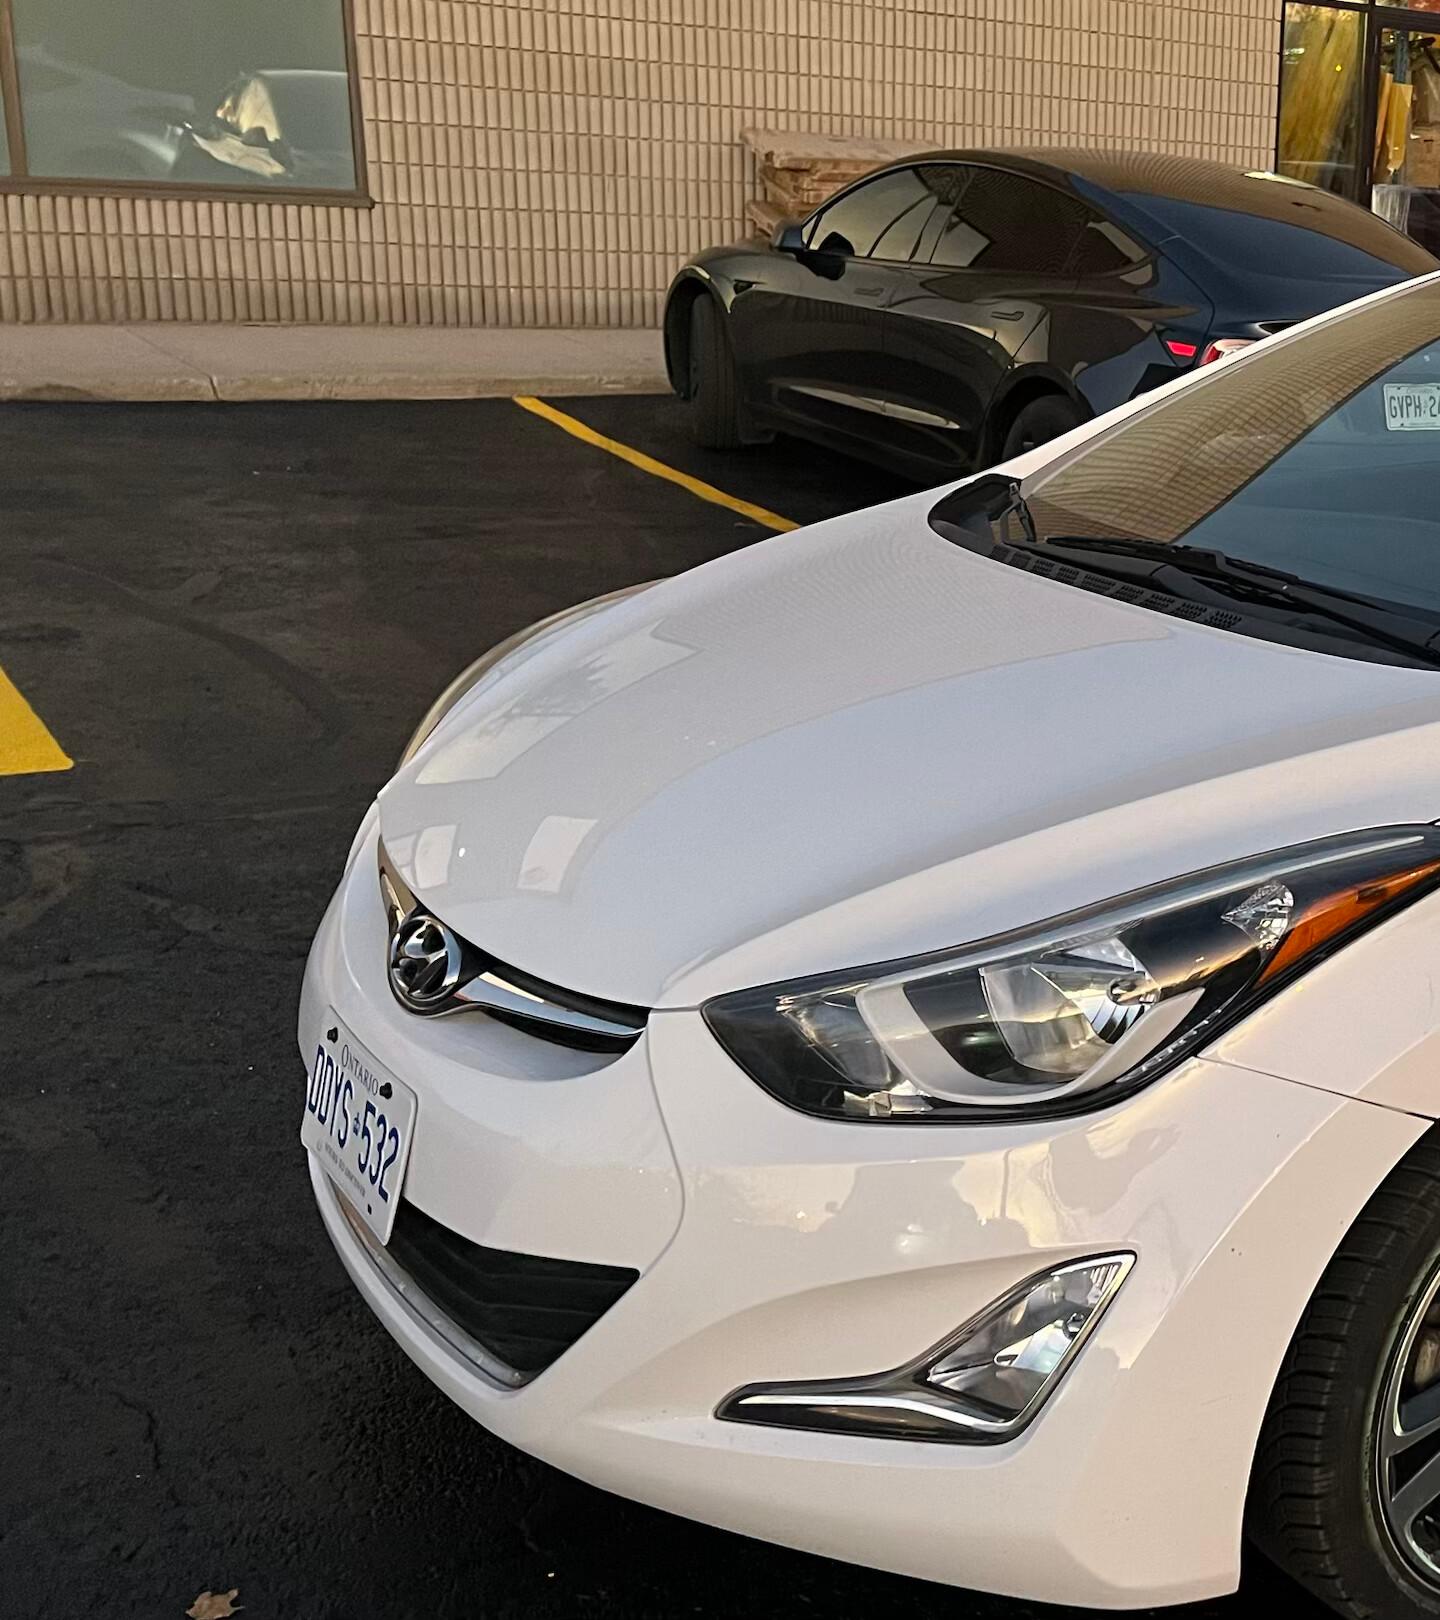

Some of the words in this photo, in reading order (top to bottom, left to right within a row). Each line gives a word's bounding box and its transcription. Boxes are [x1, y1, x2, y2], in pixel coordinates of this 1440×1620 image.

[1389, 395, 1422, 418] GVPH
[341, 1044, 379, 1097] ONTARIO
[308, 1044, 354, 1150] DDYS
[358, 1100, 400, 1204] 532
